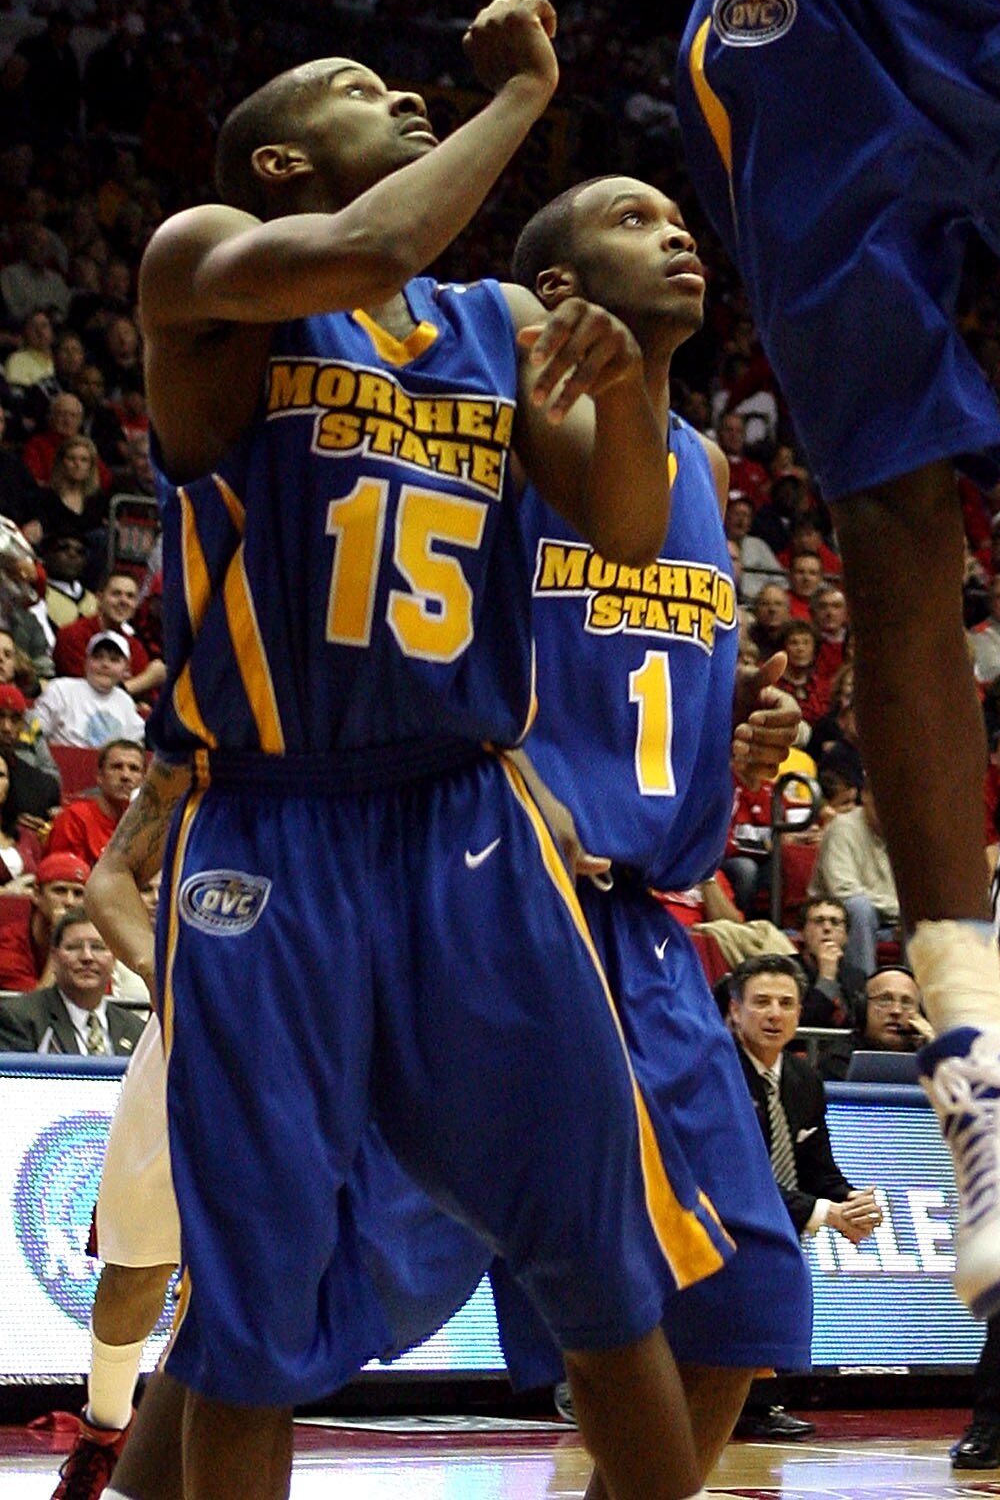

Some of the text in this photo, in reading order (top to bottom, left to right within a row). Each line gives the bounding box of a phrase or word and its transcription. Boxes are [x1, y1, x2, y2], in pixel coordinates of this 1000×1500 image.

[316, 411, 502, 491] STATE
[325, 476, 488, 663] 15
[590, 594, 716, 647] STATE
[628, 650, 676, 796] 1
[201, 888, 254, 915] OVC
